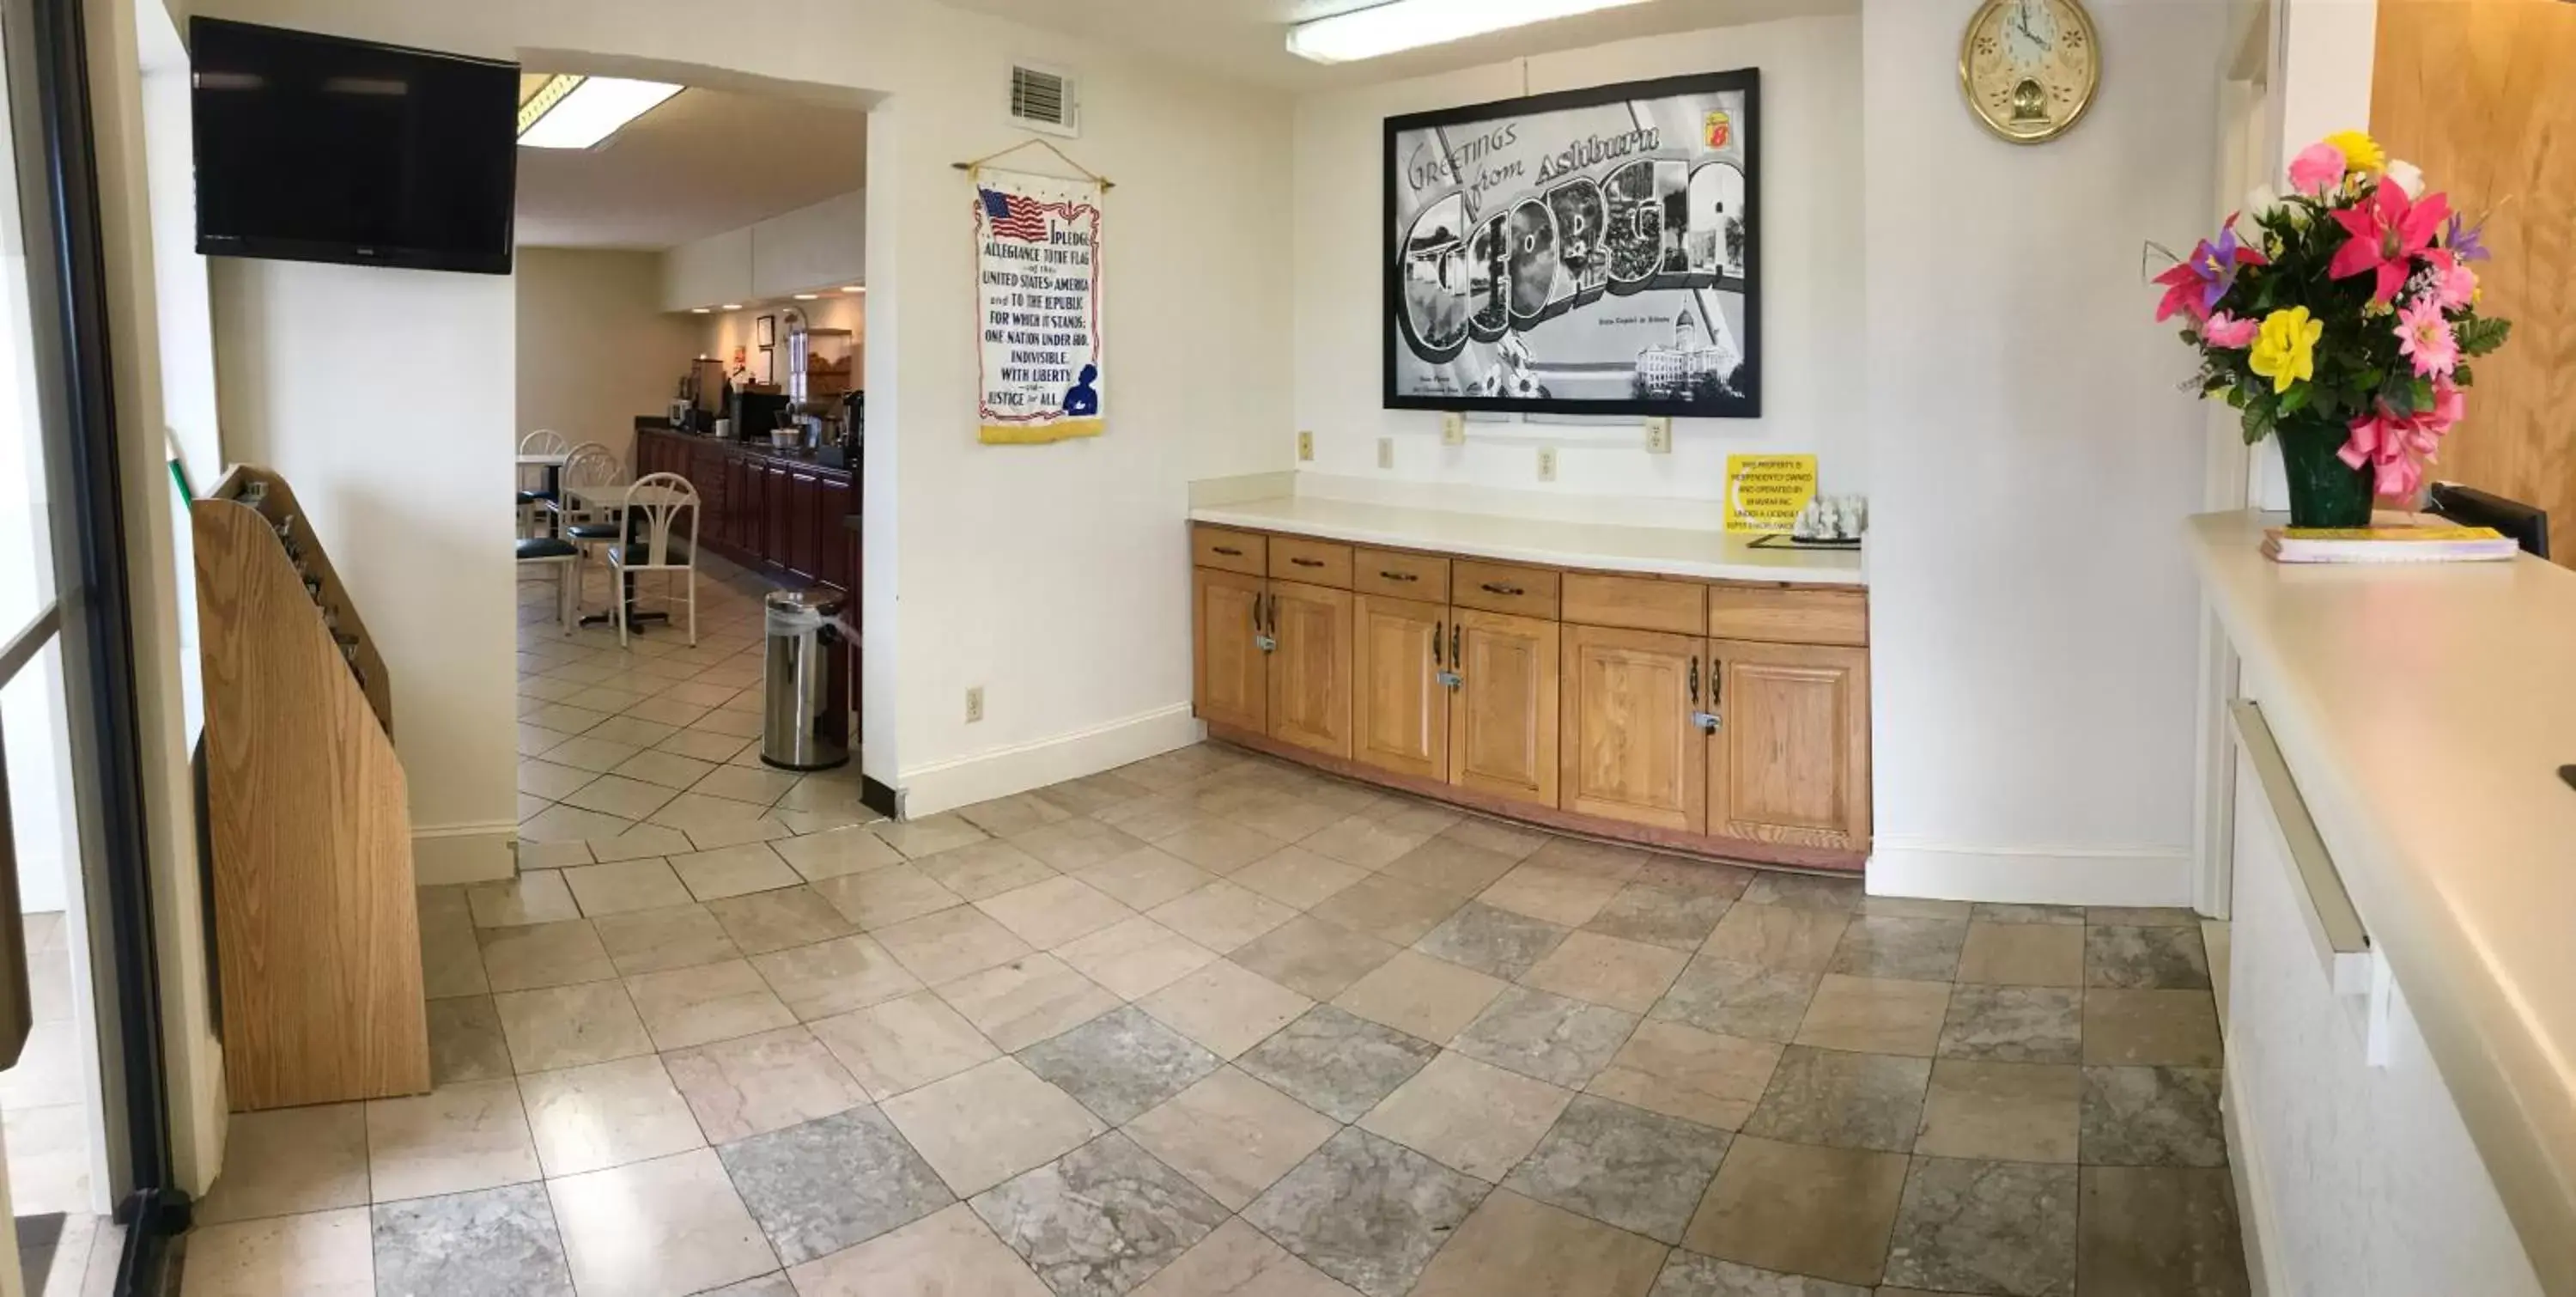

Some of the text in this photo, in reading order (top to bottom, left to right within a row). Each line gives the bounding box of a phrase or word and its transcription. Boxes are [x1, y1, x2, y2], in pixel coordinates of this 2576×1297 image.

[1407, 123, 1518, 192] GREETINGS
[1464, 126, 1660, 223] from Ashburn
[984, 243, 1040, 262] ALLEGIANCE
[1071, 251, 1089, 265] FLAG
[1400, 158, 1745, 356] GEORGIA
[982, 271, 1018, 288] UNITED
[1020, 274, 1049, 290] STATES
[1054, 277, 1089, 291] AMERICA
[1012, 293, 1024, 307] TO
[1026, 295, 1042, 308] THE
[1045, 295, 1083, 310] REPUBLIC
[990, 311, 1009, 326] FOR
[1012, 313, 1039, 327] WHICH
[985, 330, 1004, 344] ONE
[1007, 332, 1040, 345] NATION
[1042, 333, 1071, 346] UNDER
[1001, 368, 1072, 383] WITH LIBERTY
[988, 392, 1024, 406] JUSTICE
